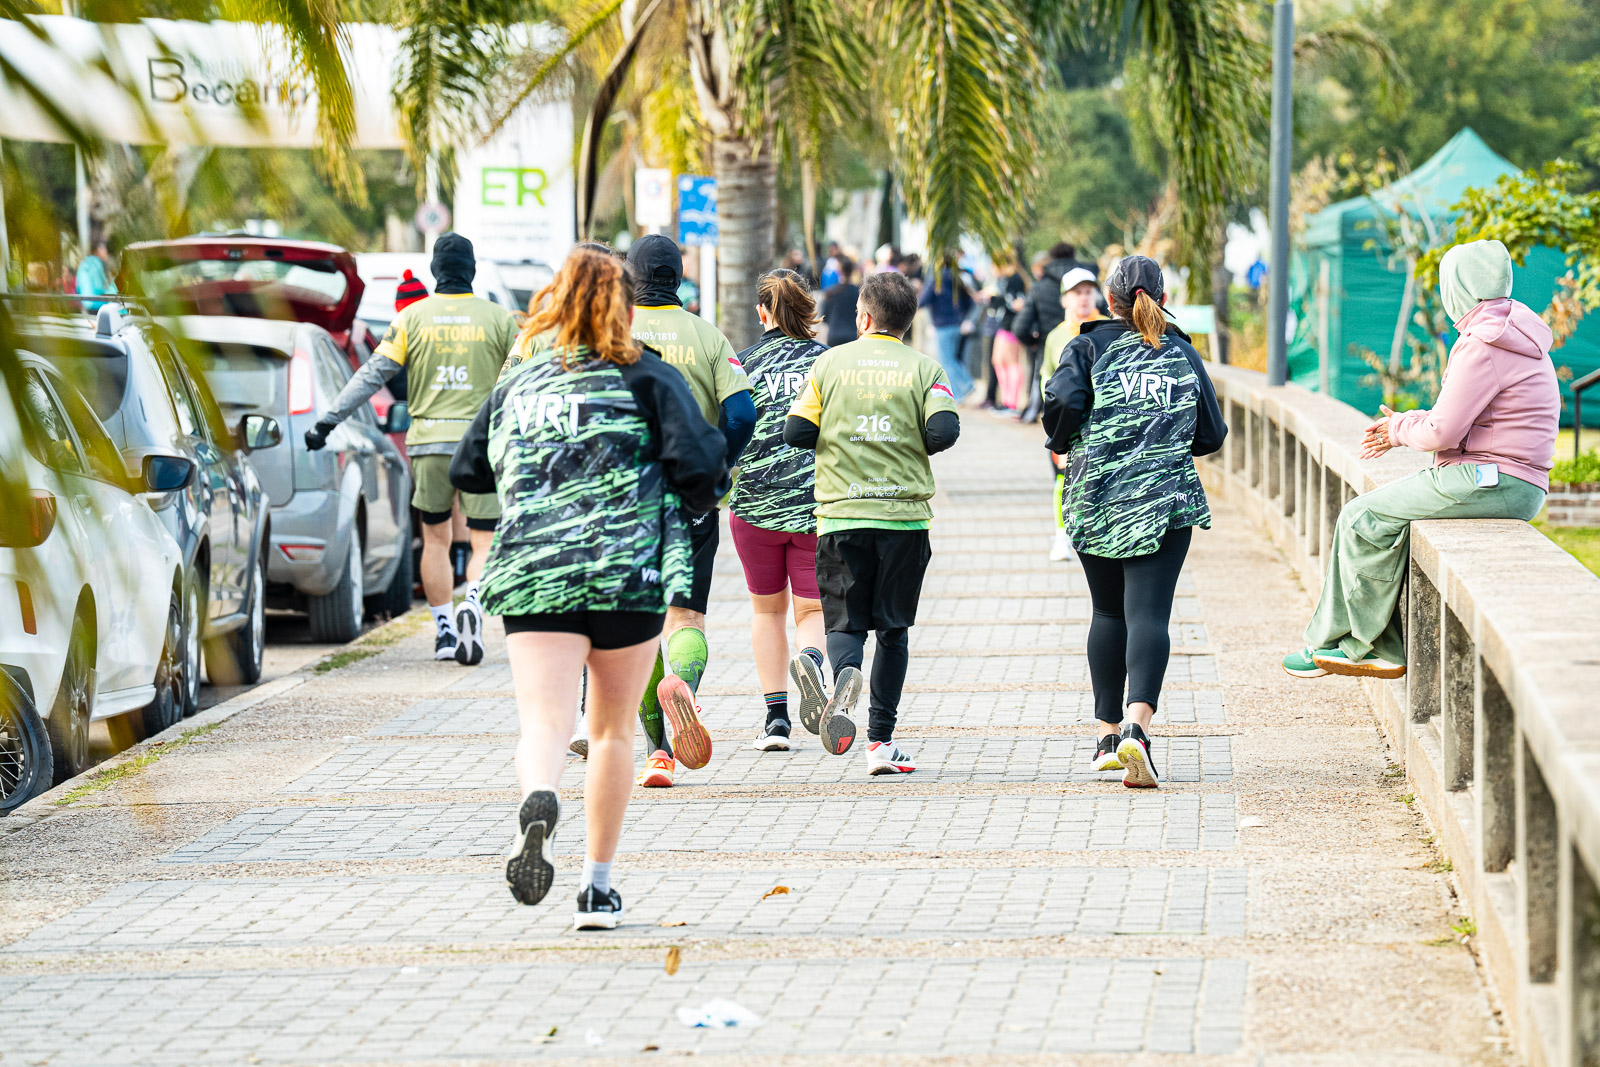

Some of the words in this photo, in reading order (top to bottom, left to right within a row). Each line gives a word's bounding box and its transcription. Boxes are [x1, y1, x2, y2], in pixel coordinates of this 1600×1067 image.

[482, 167, 546, 206] ER
[420, 325, 486, 342] VICTORIA
[856, 359, 899, 367] 13/05/1810
[436, 365, 469, 382] 216
[840, 369, 913, 387] VICTORIA
[763, 372, 809, 402] VR
[1118, 371, 1178, 410] VRT
[513, 393, 586, 438] VRT
[855, 414, 891, 432] 216
[641, 567, 661, 584] VR
